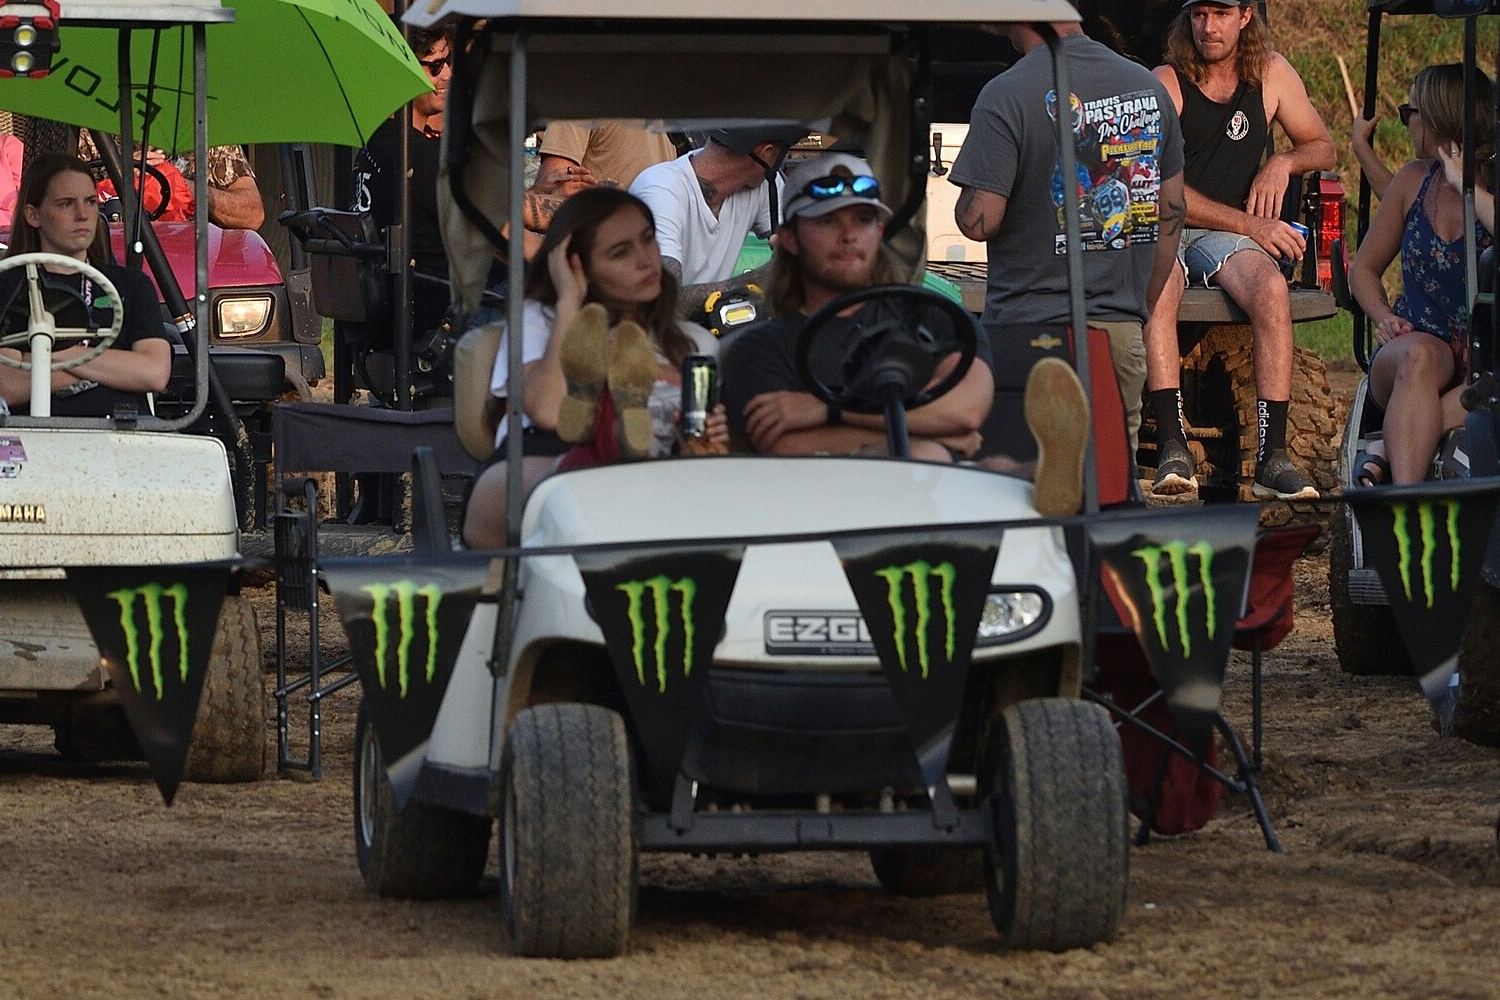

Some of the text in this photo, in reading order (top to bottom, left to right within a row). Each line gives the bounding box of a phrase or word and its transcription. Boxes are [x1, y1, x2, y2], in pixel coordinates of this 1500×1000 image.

[1083, 95, 1120, 111] TRAVIS
[1084, 96, 1159, 125] PASTRANA
[1097, 121, 1119, 143] Pro
[1257, 400, 1270, 449] adidas
